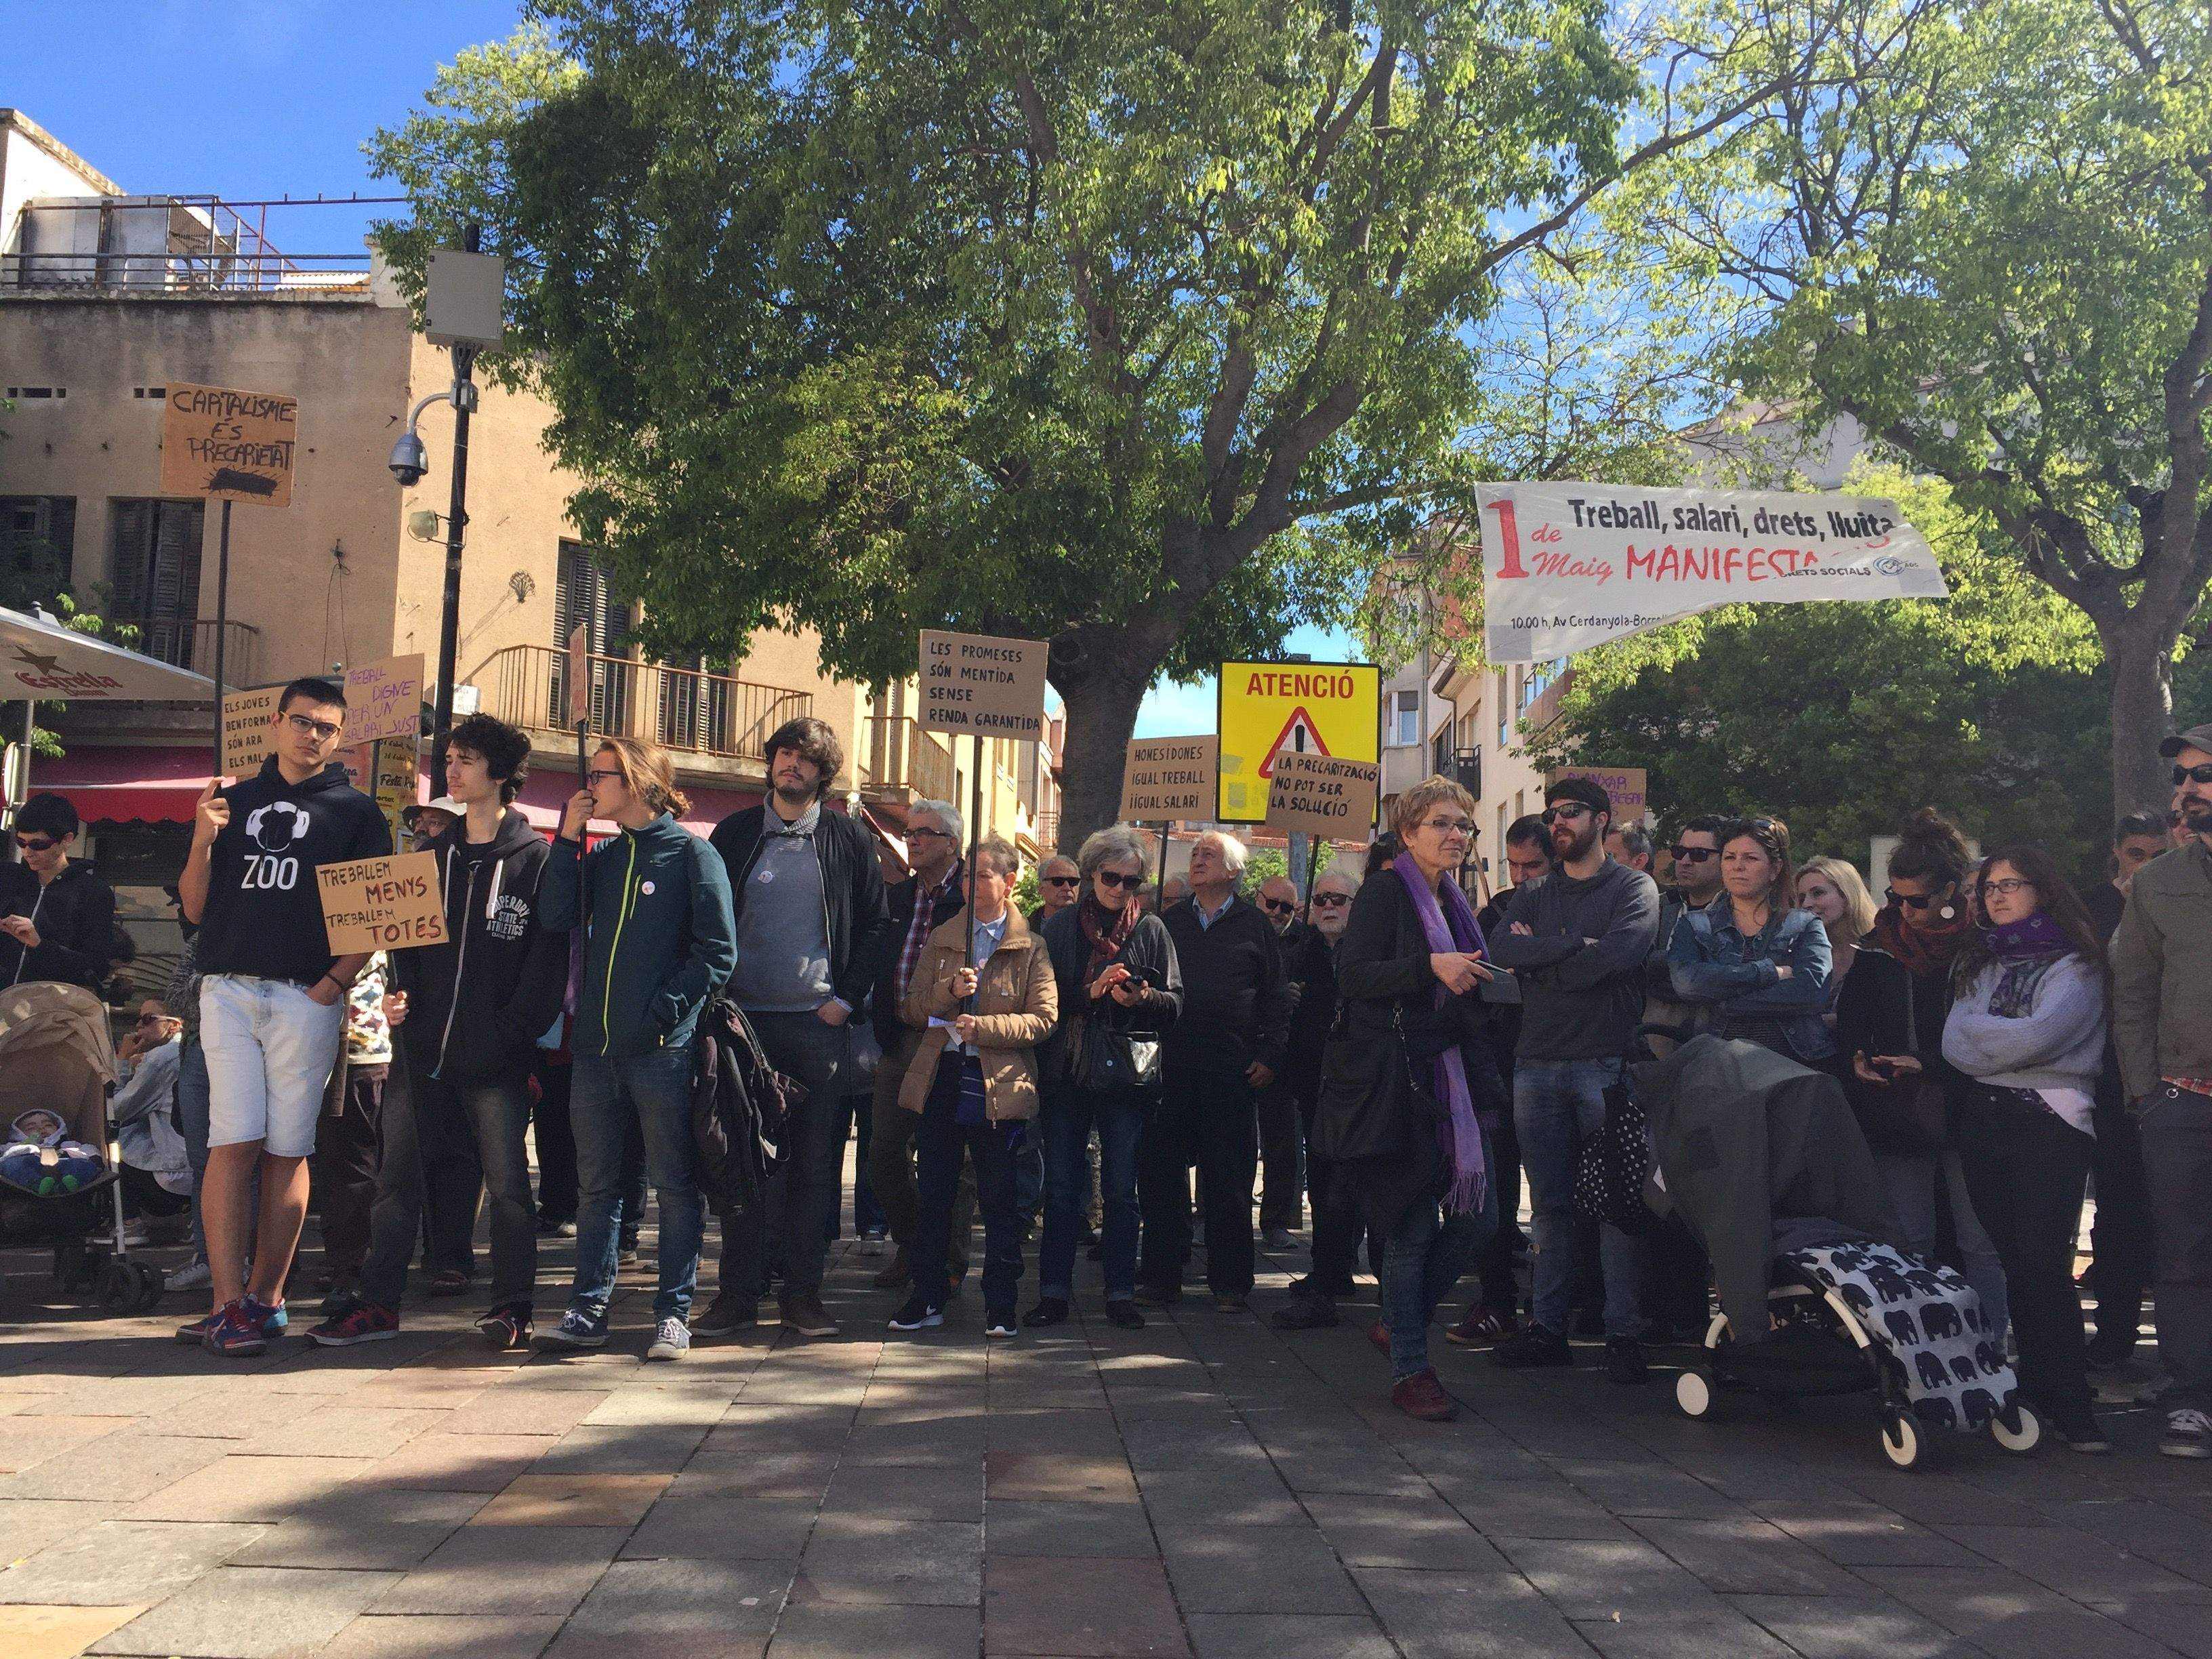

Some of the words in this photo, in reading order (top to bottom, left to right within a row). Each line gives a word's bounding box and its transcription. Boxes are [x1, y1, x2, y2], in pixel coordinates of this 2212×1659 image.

[211, 417, 243, 441] ÉS
[1568, 499, 1668, 534] Treball,
[1673, 503, 1748, 539] salari,
[1754, 507, 1825, 542] drets,
[1486, 499, 1530, 579] 1
[1531, 523, 1562, 543] de
[1532, 551, 1614, 586] Maig
[1820, 567, 1871, 576] SOCIALS
[1511, 616, 1539, 629] 10.00
[1541, 616, 1551, 630] h,
[1553, 615, 1567, 628] Av
[930, 642, 951, 655] LES
[962, 644, 1022, 663] PROMESES
[349, 666, 386, 687] TREBALL
[929, 661, 951, 678] SÓN
[960, 667, 1015, 684] MENTIDA
[929, 687, 973, 701] SENSE
[1246, 669, 1354, 699] ATENCIÓ
[224, 701, 240, 713] ELS
[242, 697, 270, 710] JOVES
[374, 699, 398, 718] UN
[226, 719, 241, 732] BEN
[243, 714, 271, 728] FORMA
[929, 708, 968, 724] RENDA
[975, 714, 1040, 731] GARANTIDA
[227, 733, 243, 750] SÓN
[246, 735, 262, 746] ARA
[229, 756, 245, 768] ELS
[247, 753, 264, 764] MAL
[1134, 747, 1164, 762] HOMES
[1171, 745, 1203, 760] DONES
[1278, 756, 1292, 771] LA
[1132, 769, 1159, 785] IGUAL
[1162, 770, 1205, 784] TREBALL
[1275, 775, 1291, 791] NO
[1294, 779, 1315, 792] POT
[1318, 782, 1343, 796] SER
[1164, 792, 1200, 809] SALARI
[1271, 795, 1286, 809] LA
[1290, 797, 1351, 817] SOLUCIÓ
[241, 855, 299, 890] ZOO
[319, 861, 391, 888] TREBALLEM
[365, 876, 428, 904] MENYS
[326, 909, 396, 928] TREBALLEM
[498, 911, 518, 924] STATE
[365, 914, 441, 945] TOTES
[486, 920, 524, 937] ATHLETICS
